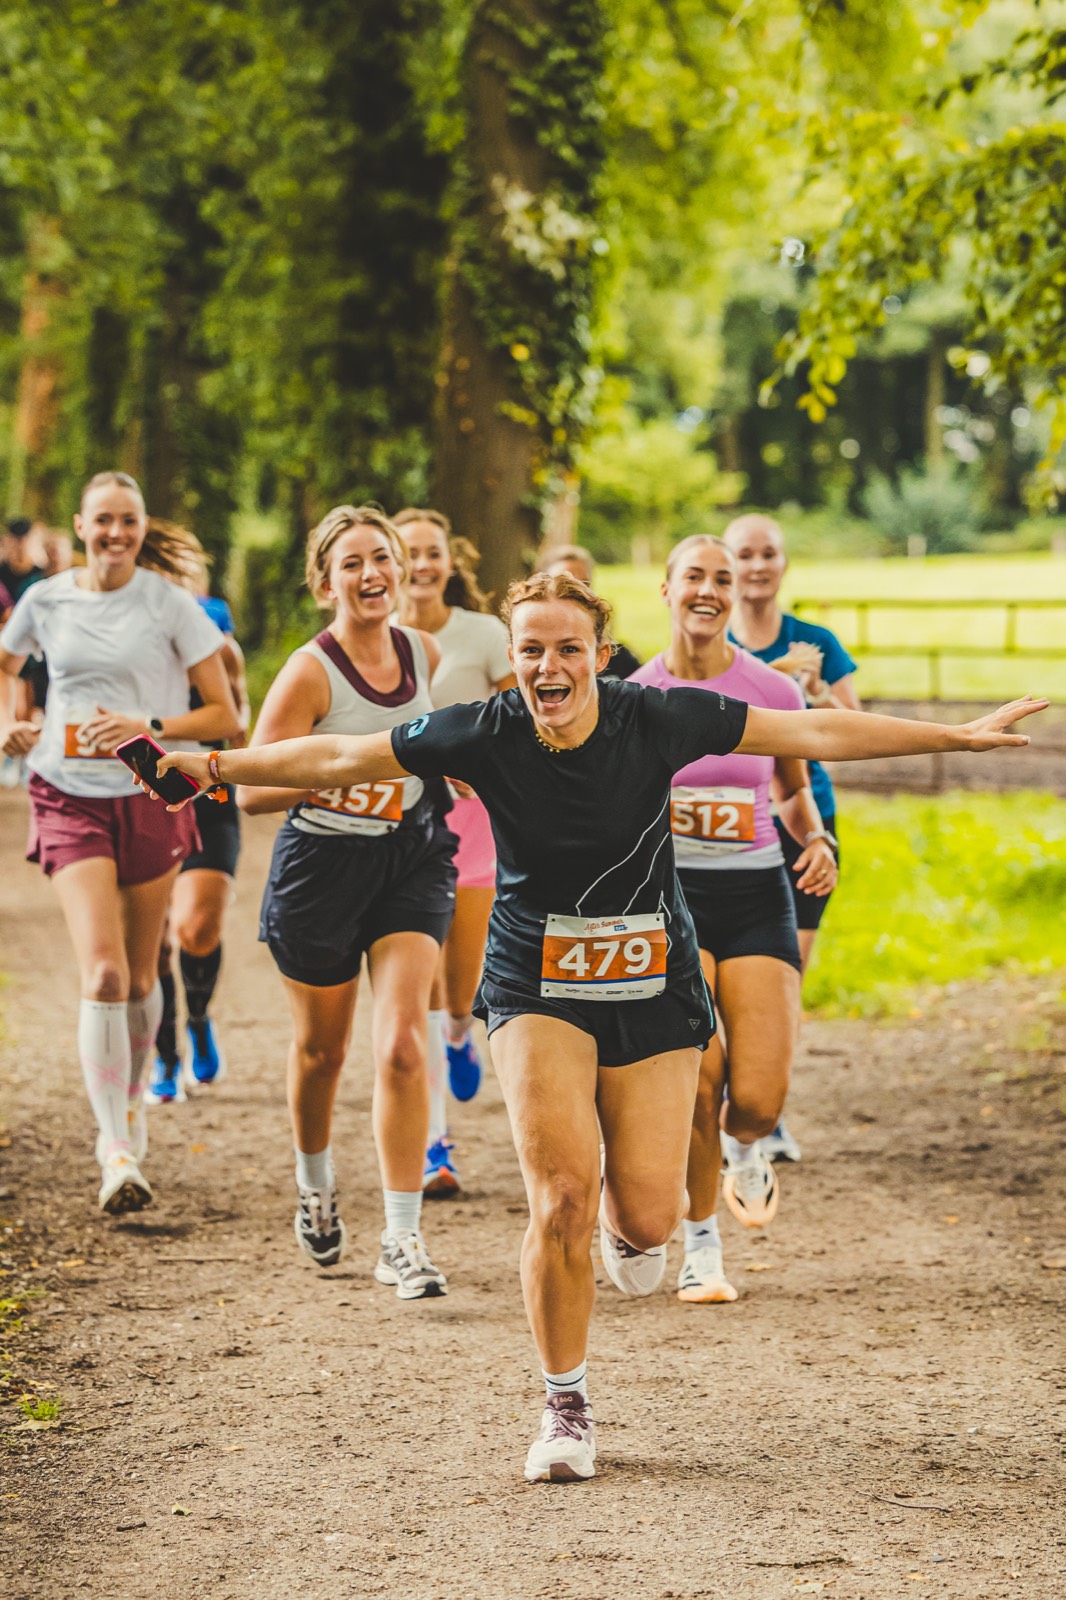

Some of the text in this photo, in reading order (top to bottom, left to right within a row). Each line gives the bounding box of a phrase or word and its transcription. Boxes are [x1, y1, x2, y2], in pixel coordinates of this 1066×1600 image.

[317, 783, 395, 815] 457
[672, 803, 740, 838] 512
[558, 938, 651, 976] 479
